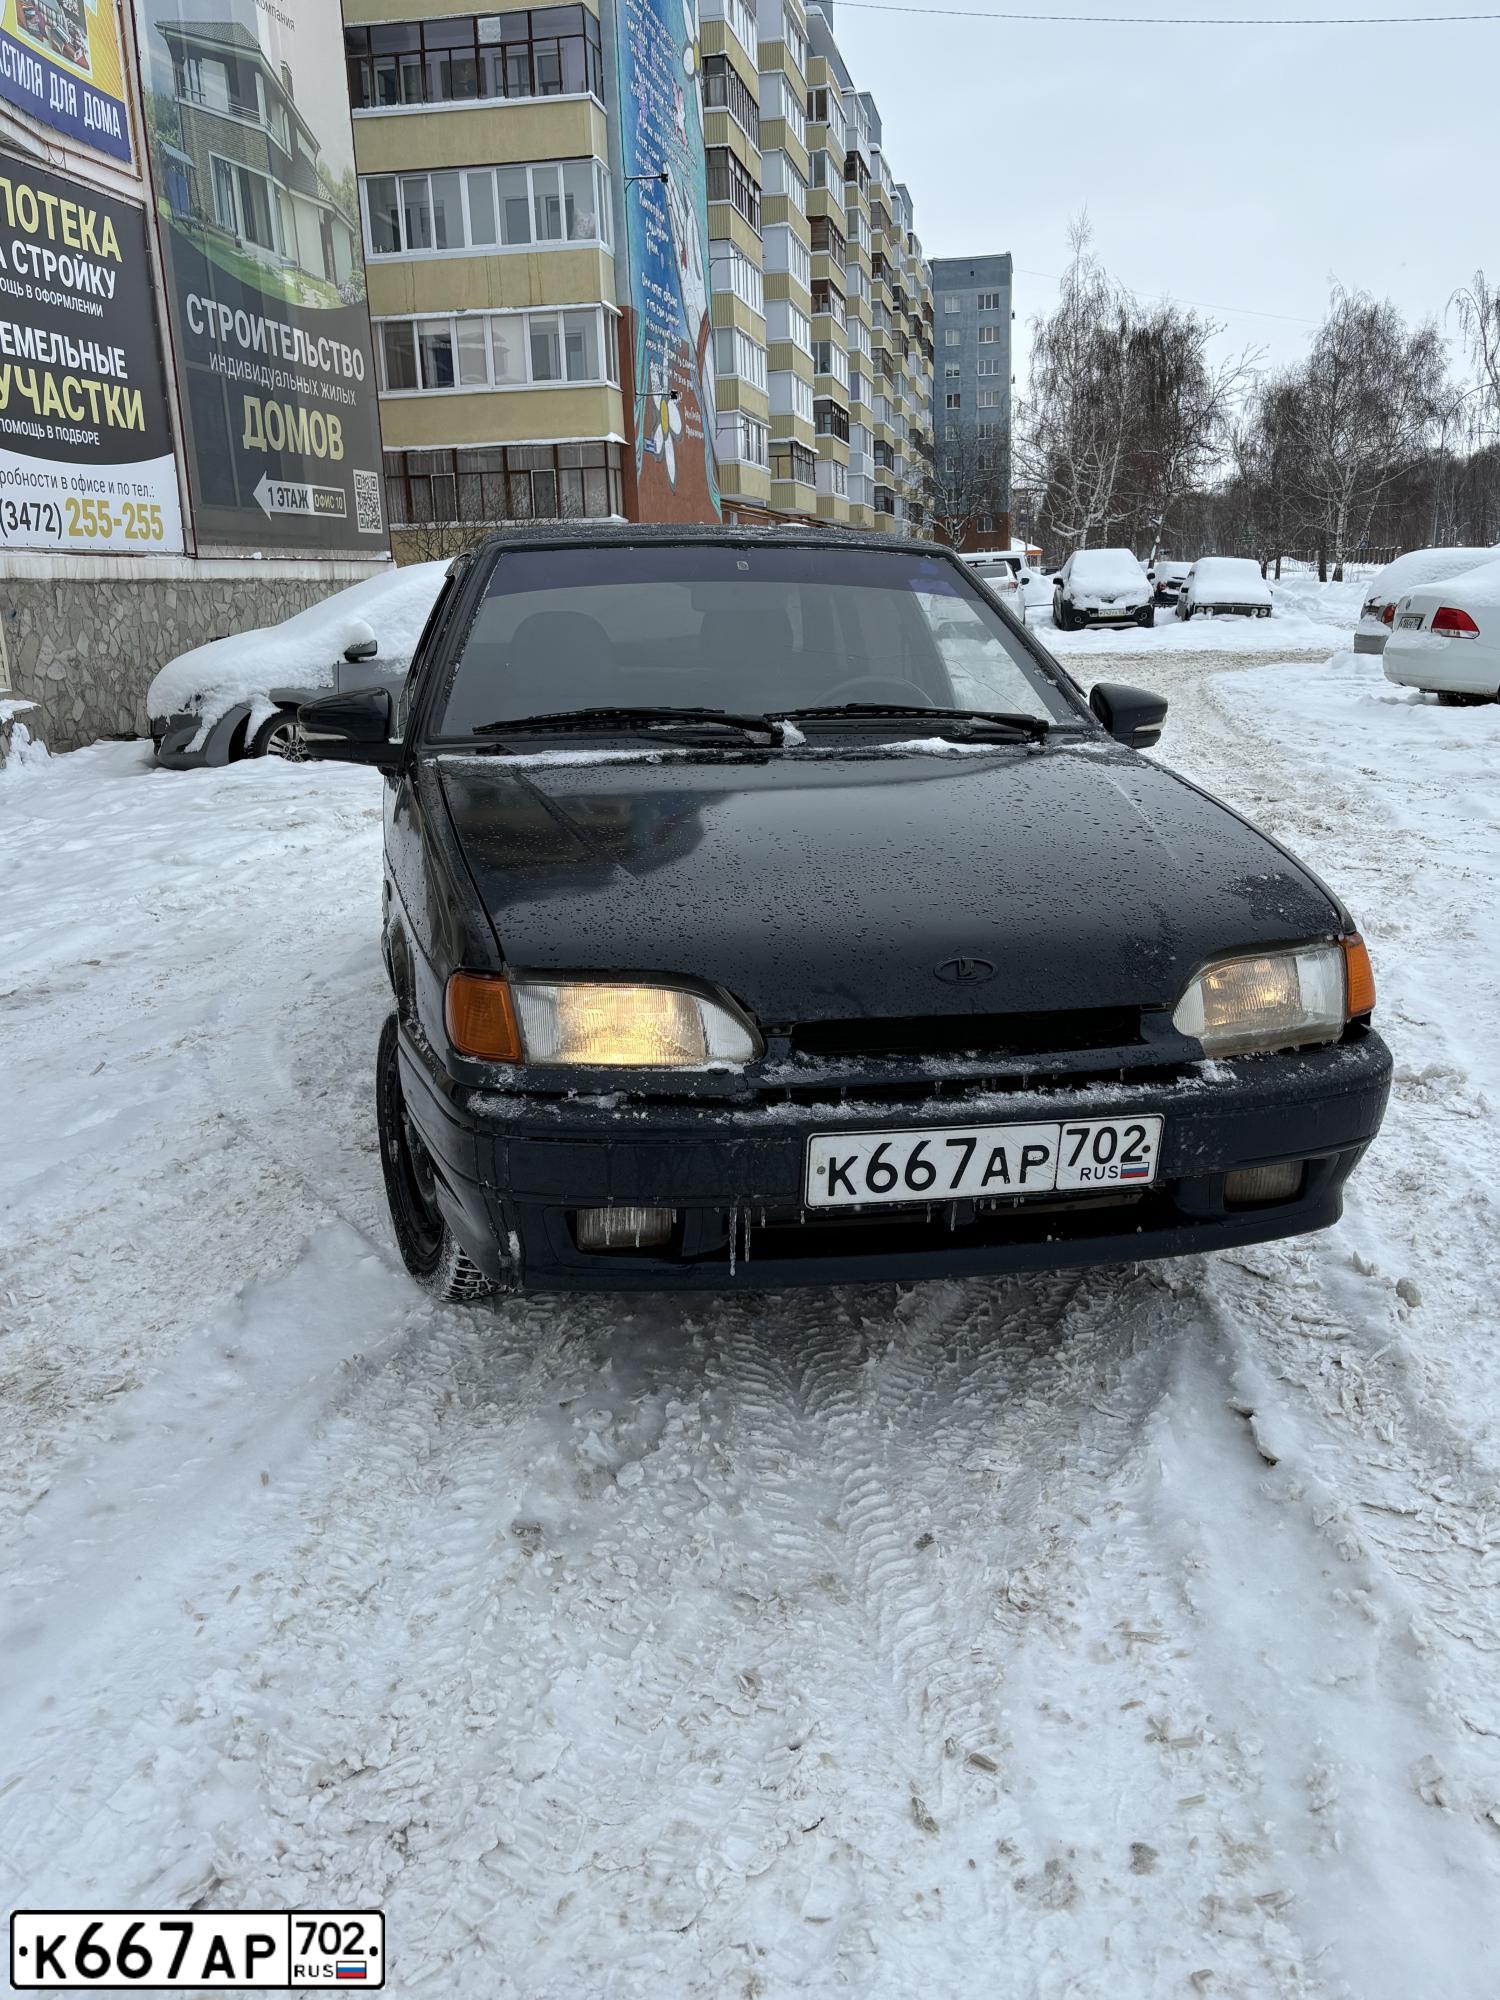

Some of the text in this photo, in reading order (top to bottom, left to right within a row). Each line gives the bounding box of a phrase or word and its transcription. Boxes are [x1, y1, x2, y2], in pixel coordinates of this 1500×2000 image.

[0, 39, 122, 140] СТИЛЯ ДЛЯ ДОМА
[12, 240, 115, 299] СТРОЙКУ
[26, 284, 33, 299] В
[35, 287, 104, 318] ОФОРМЛЕНИИ
[0, 321, 128, 379] ЕМЕЛЬНЫЕ
[186, 293, 365, 381] СТРОИТЕЛЬСТВО
[0, 363, 146, 432] УЧАСТКИ
[47, 425, 54, 439] В
[55, 426, 101, 446] ПОДБОРЕ
[243, 394, 344, 461] ДОМОВ
[61, 476, 68, 490] в
[71, 474, 105, 495] офисе
[109, 481, 115, 494] и
[118, 482, 130, 496] по
[132, 484, 155, 498] тел.:
[268, 486, 274, 507] 1
[277, 486, 310, 509] ЭТАЖ
[314, 493, 335, 509] ОФИС
[65, 497, 164, 541] 255-255
[1066, 1125, 1147, 1167] 702
[1080, 1166, 1119, 1181] RUS
